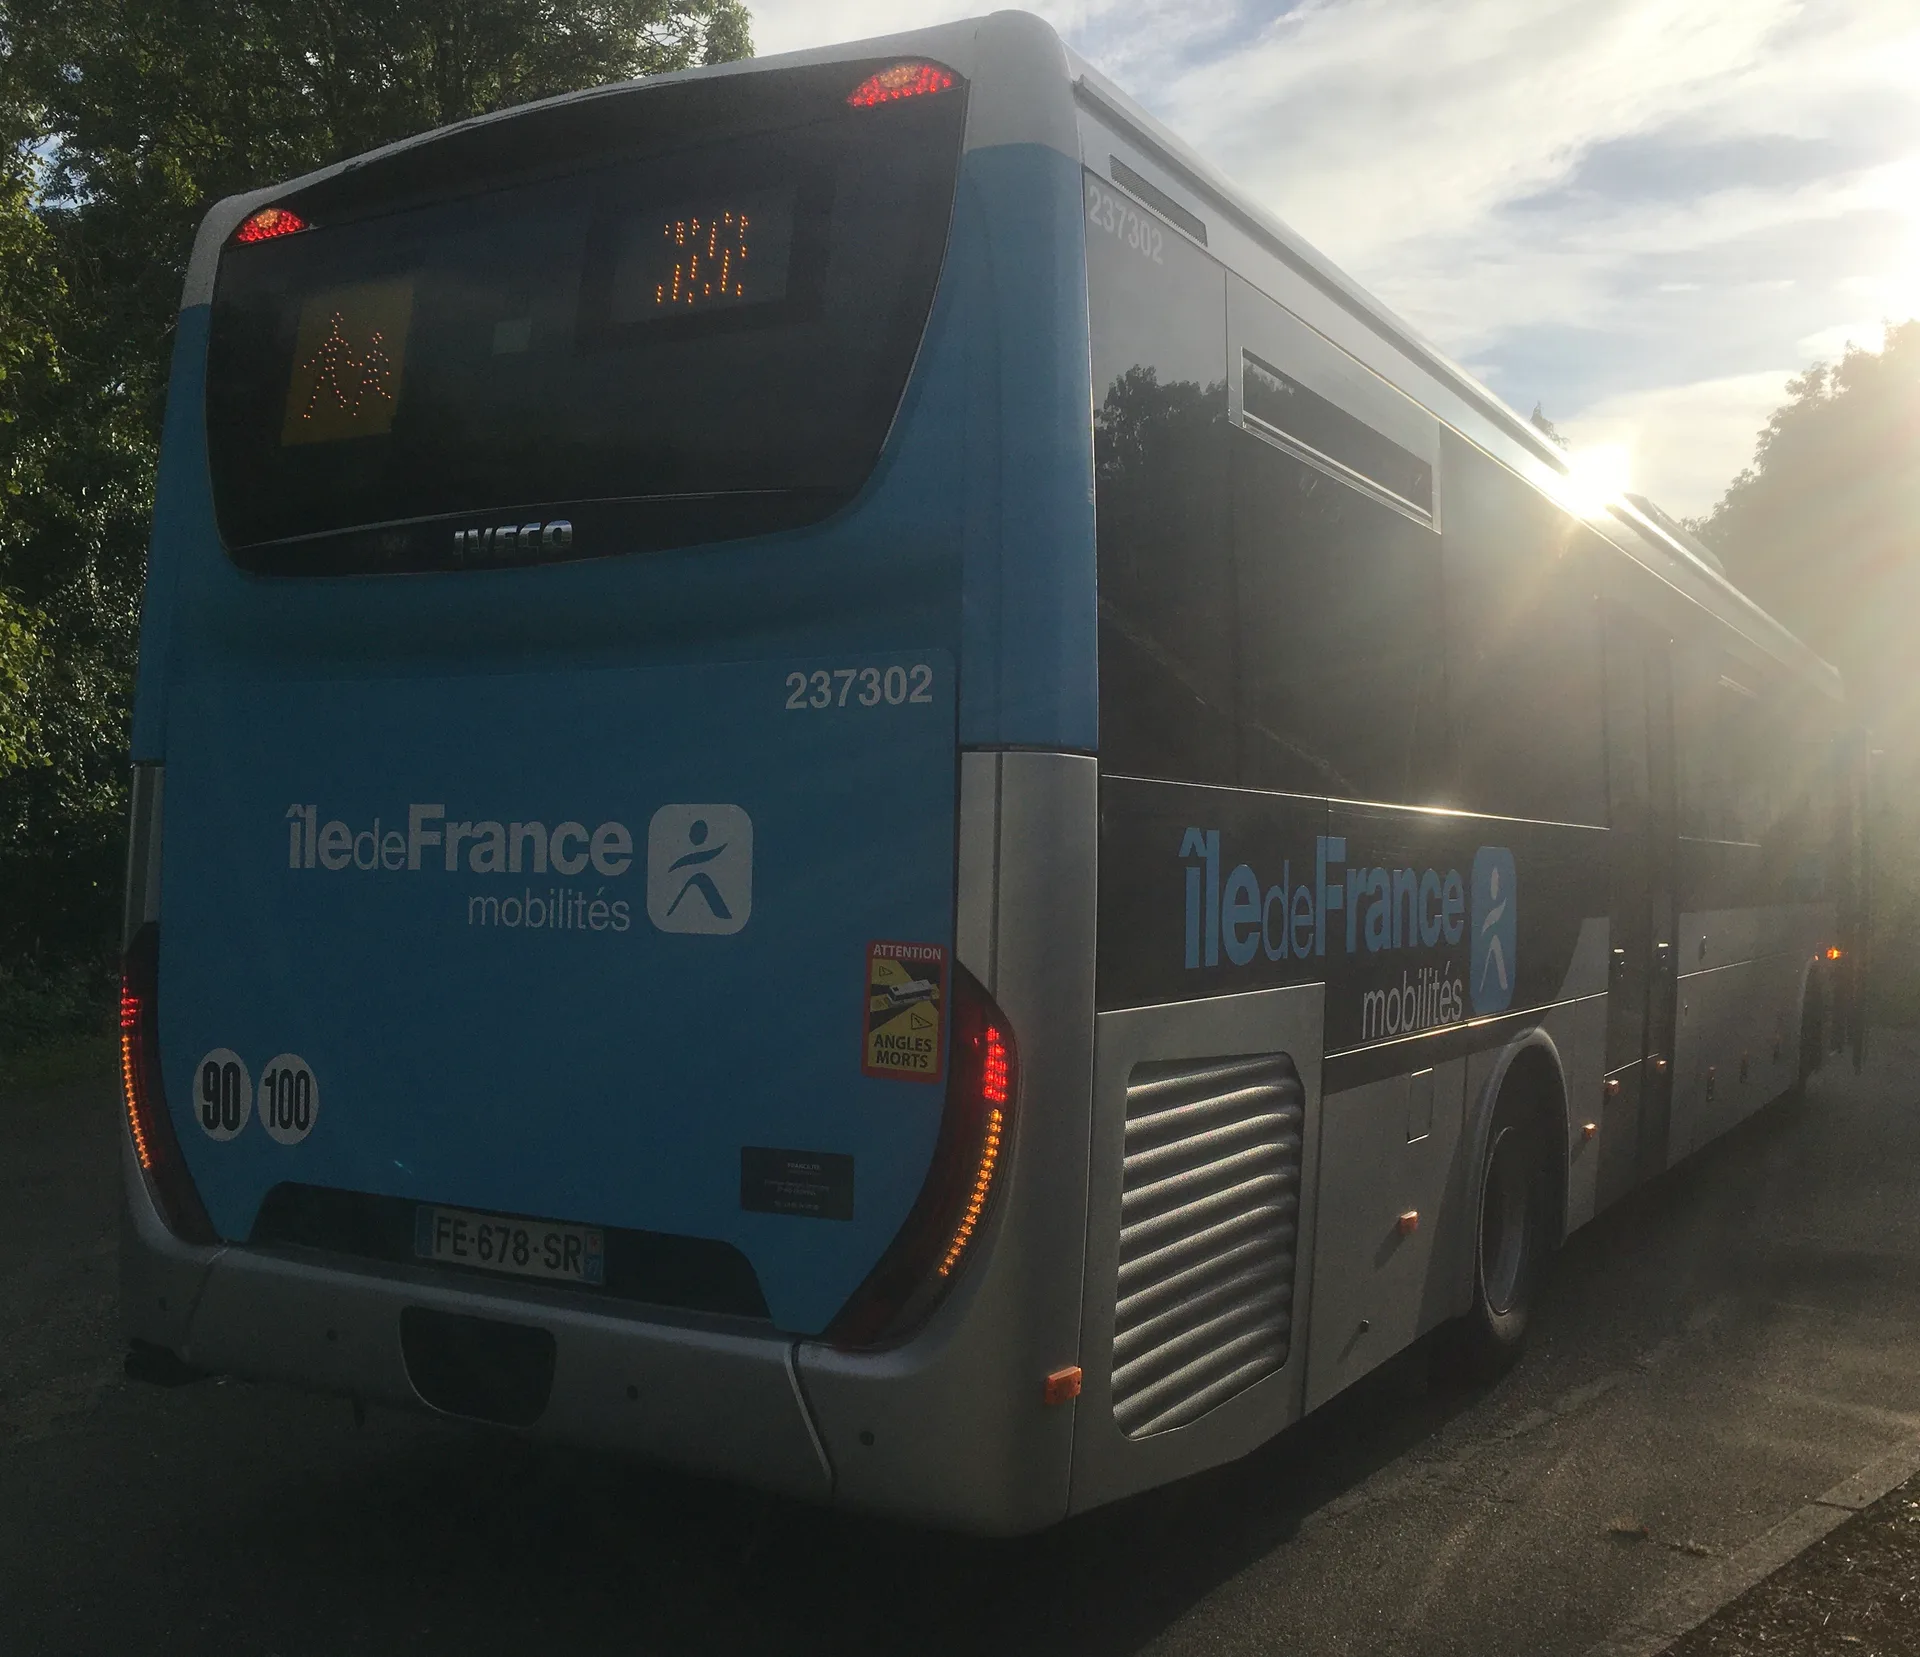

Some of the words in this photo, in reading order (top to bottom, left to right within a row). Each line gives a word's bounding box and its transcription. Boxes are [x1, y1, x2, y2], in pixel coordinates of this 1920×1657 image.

[1089, 184, 1164, 265] 237302
[453, 519, 573, 561] IVECO
[785, 664, 933, 710] 237302
[468, 885, 632, 932] mobilités
[872, 944, 942, 960] ATTENTION
[1361, 960, 1464, 1040] mobilités
[873, 1033, 933, 1053] ANGLES
[876, 1050, 929, 1069] MORTS
[202, 1060, 241, 1131] 90
[264, 1068, 311, 1131] 100
